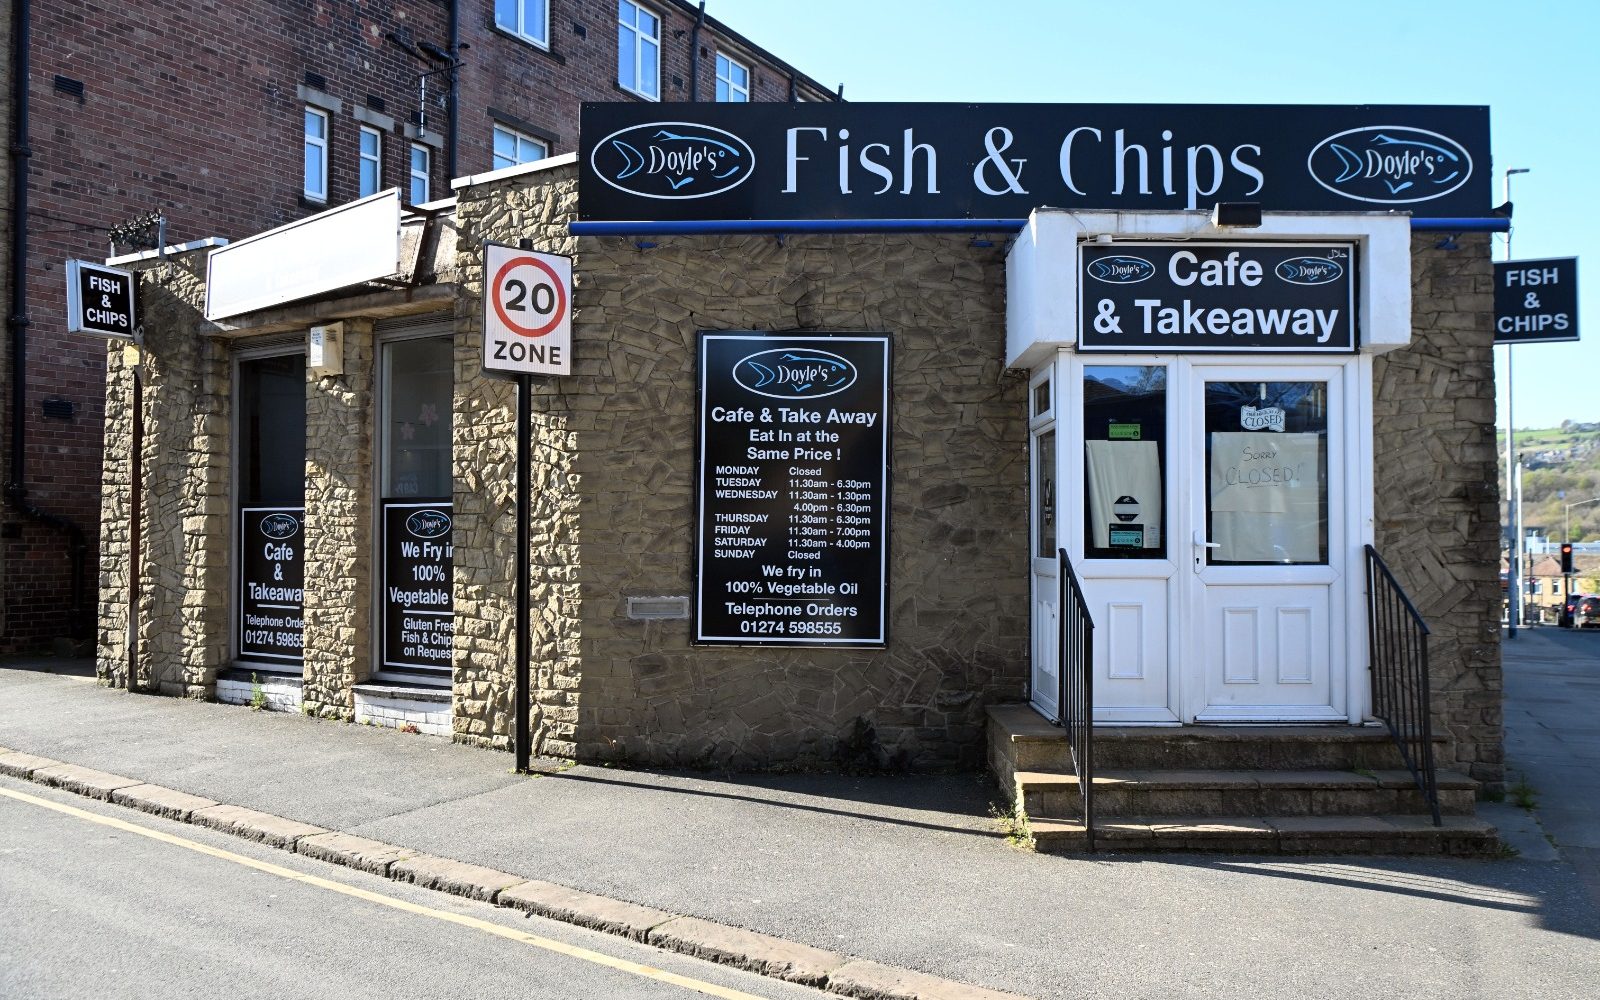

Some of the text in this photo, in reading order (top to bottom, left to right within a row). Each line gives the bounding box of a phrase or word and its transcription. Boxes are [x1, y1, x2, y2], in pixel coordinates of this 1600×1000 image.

[647, 146, 717, 175] Doyle's
[1364, 150, 1434, 179] Doyle's
[782, 126, 1264, 210] Fish & Chips
[1111, 264, 1139, 276] Doyle's
[1169, 251, 1263, 286] Cafe
[1300, 266, 1327, 277] Doyle's
[1506, 268, 1558, 286] FISH
[90, 276, 120, 294] FISH
[102, 295, 111, 308] &
[505, 280, 554, 314] 20
[1524, 292, 1540, 308] &
[87, 308, 127, 327] CHIPS
[1094, 299, 1338, 342] & Takeaway
[1498, 313, 1568, 333] CHIPS
[494, 340, 561, 365] ZONE
[777, 365, 827, 384] Doyle's
[712, 407, 877, 427] Cafe & Take Away
[1244, 415, 1282, 427] CLOSED
[750, 429, 839, 442] Eat In at the
[747, 447, 789, 459] Same
[794, 448, 832, 460] Price
[716, 466, 822, 476] MONDAY Closed
[716, 478, 761, 486] TUESDAY
[789, 480, 827, 488] 11.30am
[837, 480, 871, 489] 6.30pm
[716, 490, 778, 498] WEDNESDAY
[789, 492, 827, 500] 11.30am
[838, 492, 871, 501] 1.30pm
[794, 504, 827, 513] 4.00pm
[837, 504, 871, 513] 6.30pm
[715, 514, 768, 522] THURSDAY
[789, 515, 827, 524] 11.30am
[837, 516, 870, 525] 6.30pm
[715, 526, 750, 534] FRIDAY
[789, 527, 827, 536] 11.30am
[837, 528, 870, 537] 7.00pm
[715, 538, 767, 546] SATURDAY
[789, 539, 827, 548] 11.30am
[836, 540, 870, 549] 4.00pm
[264, 543, 293, 561] Cafe
[401, 542, 421, 557] We
[423, 543, 442, 561] Fry
[715, 550, 820, 559] SUNDAY Closed
[274, 564, 283, 581] &
[413, 566, 445, 582] 100%
[762, 565, 821, 579] We fry in
[726, 582, 857, 596] 100% Vegetable Oil
[390, 587, 448, 607] Vegetable
[725, 602, 857, 617] Telephone Orders
[246, 615, 283, 628] Telephone
[404, 618, 453, 632] Gluten Free
[741, 621, 841, 634] 01274 598555
[246, 630, 274, 645] 01274
[402, 631, 419, 644] Fish
[422, 632, 432, 643] &
[404, 648, 415, 656] on
